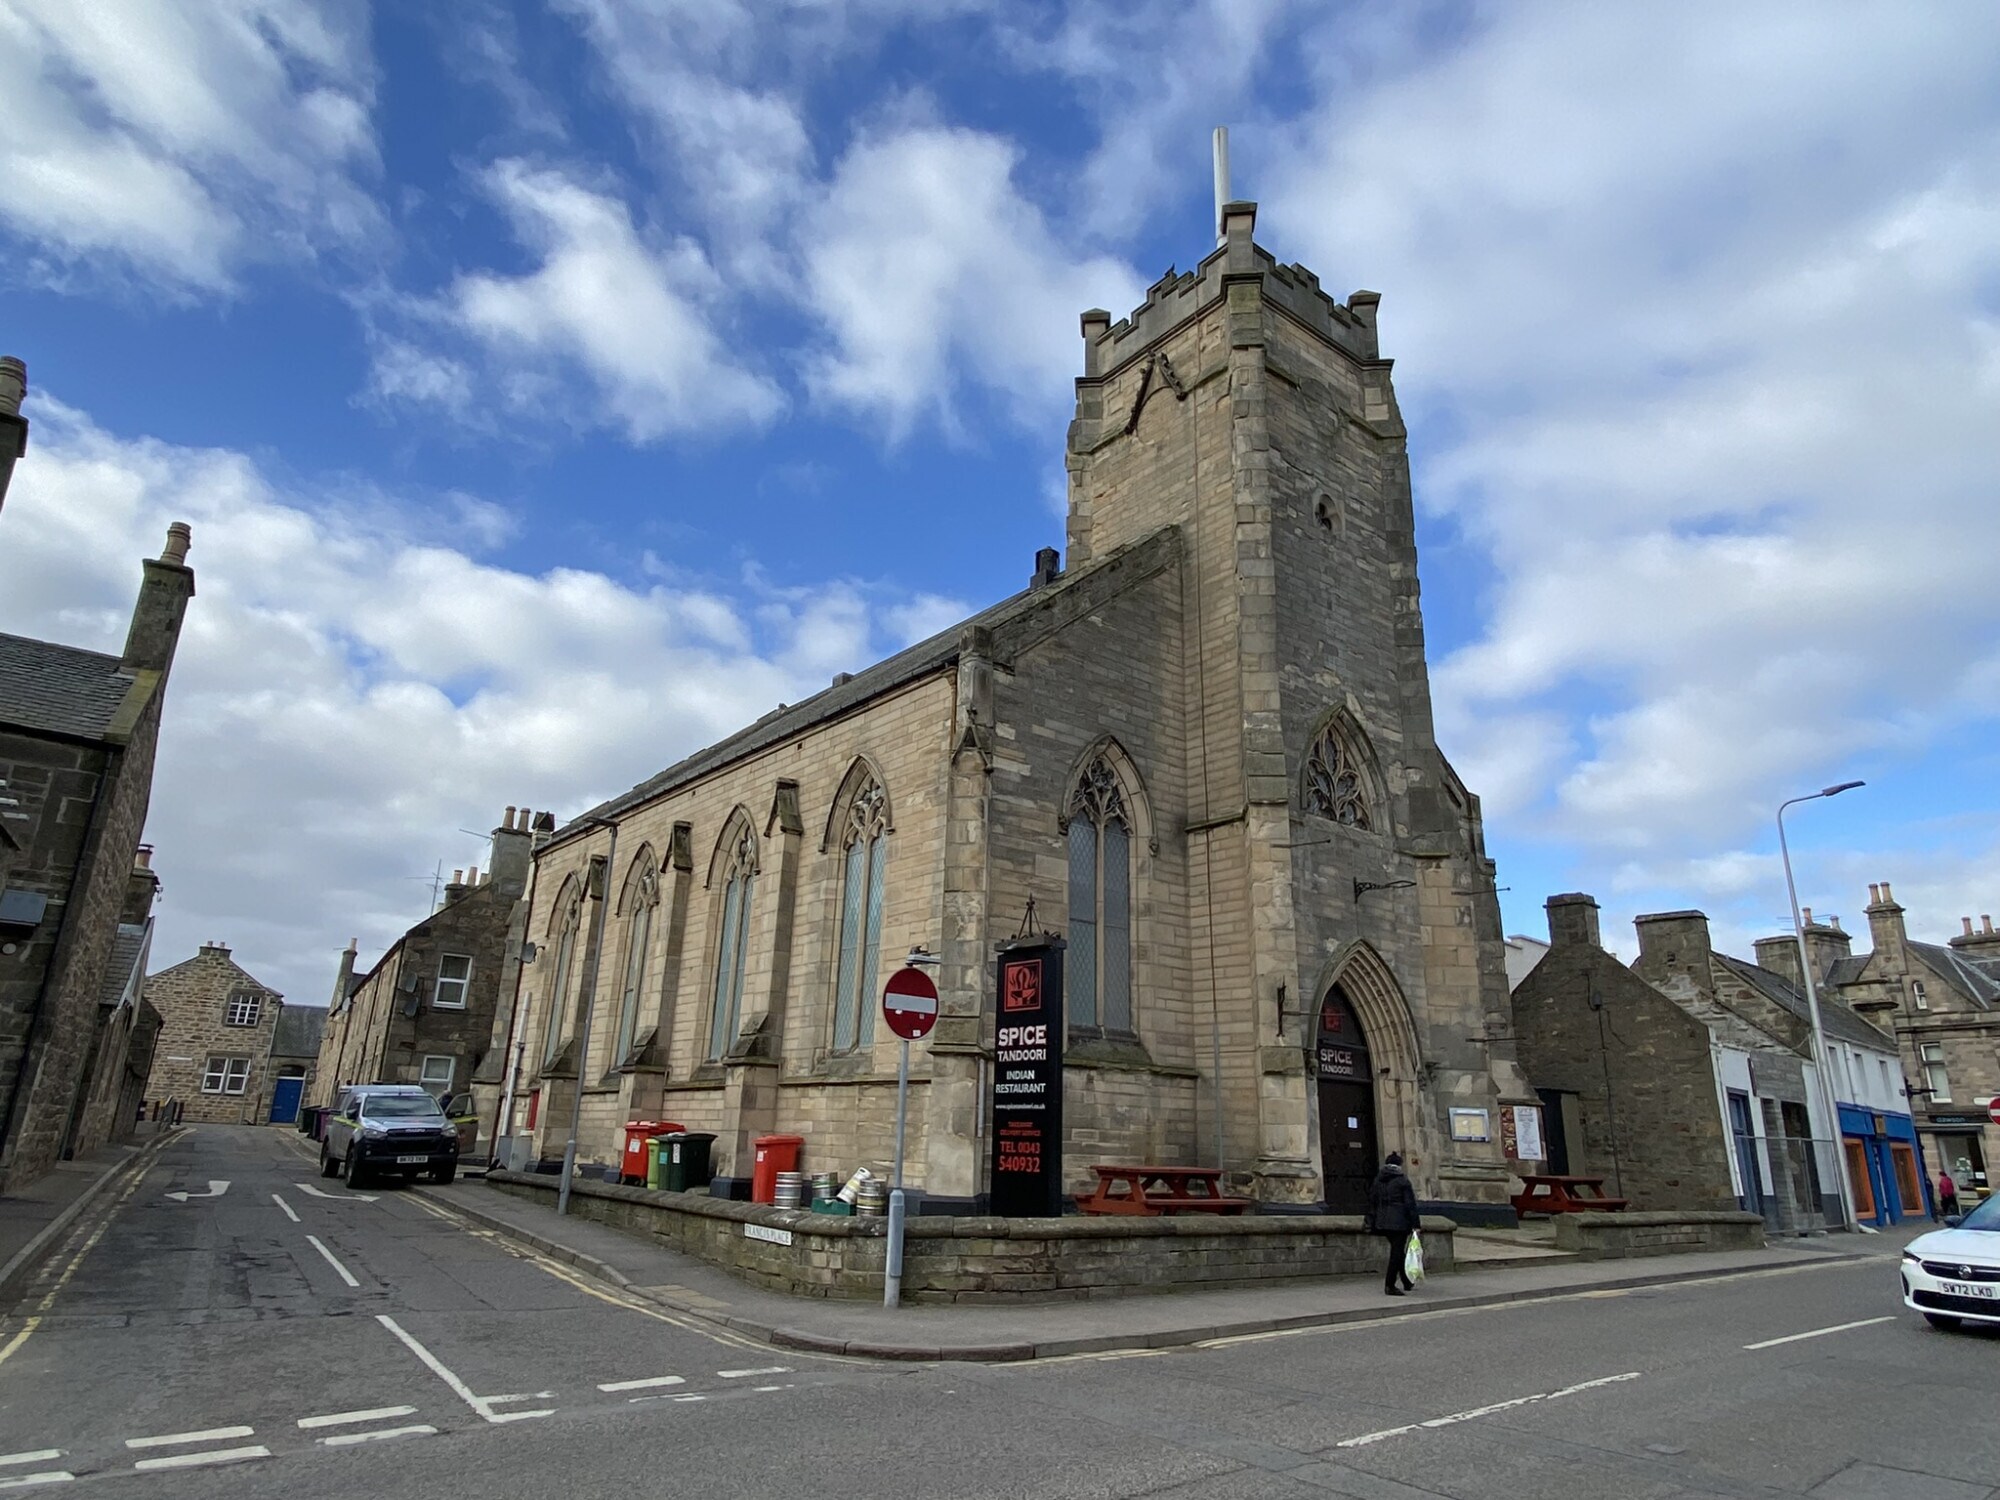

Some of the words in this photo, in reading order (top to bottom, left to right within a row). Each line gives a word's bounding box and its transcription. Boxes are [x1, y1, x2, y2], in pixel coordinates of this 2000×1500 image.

[998, 1024, 1047, 1046] SPICE
[997, 1049, 1047, 1062] TANDOORI
[1320, 1048, 1352, 1064] SPICE
[1006, 1069, 1035, 1080] INDIAN
[1321, 1064, 1353, 1074] TANDOORI
[995, 1083, 1046, 1094] RESTAURANT
[1000, 1141, 1016, 1153] TEL
[1017, 1141, 1041, 1154] 01343
[999, 1155, 1041, 1173] 540932
[1942, 1283, 1970, 1295] SW72
